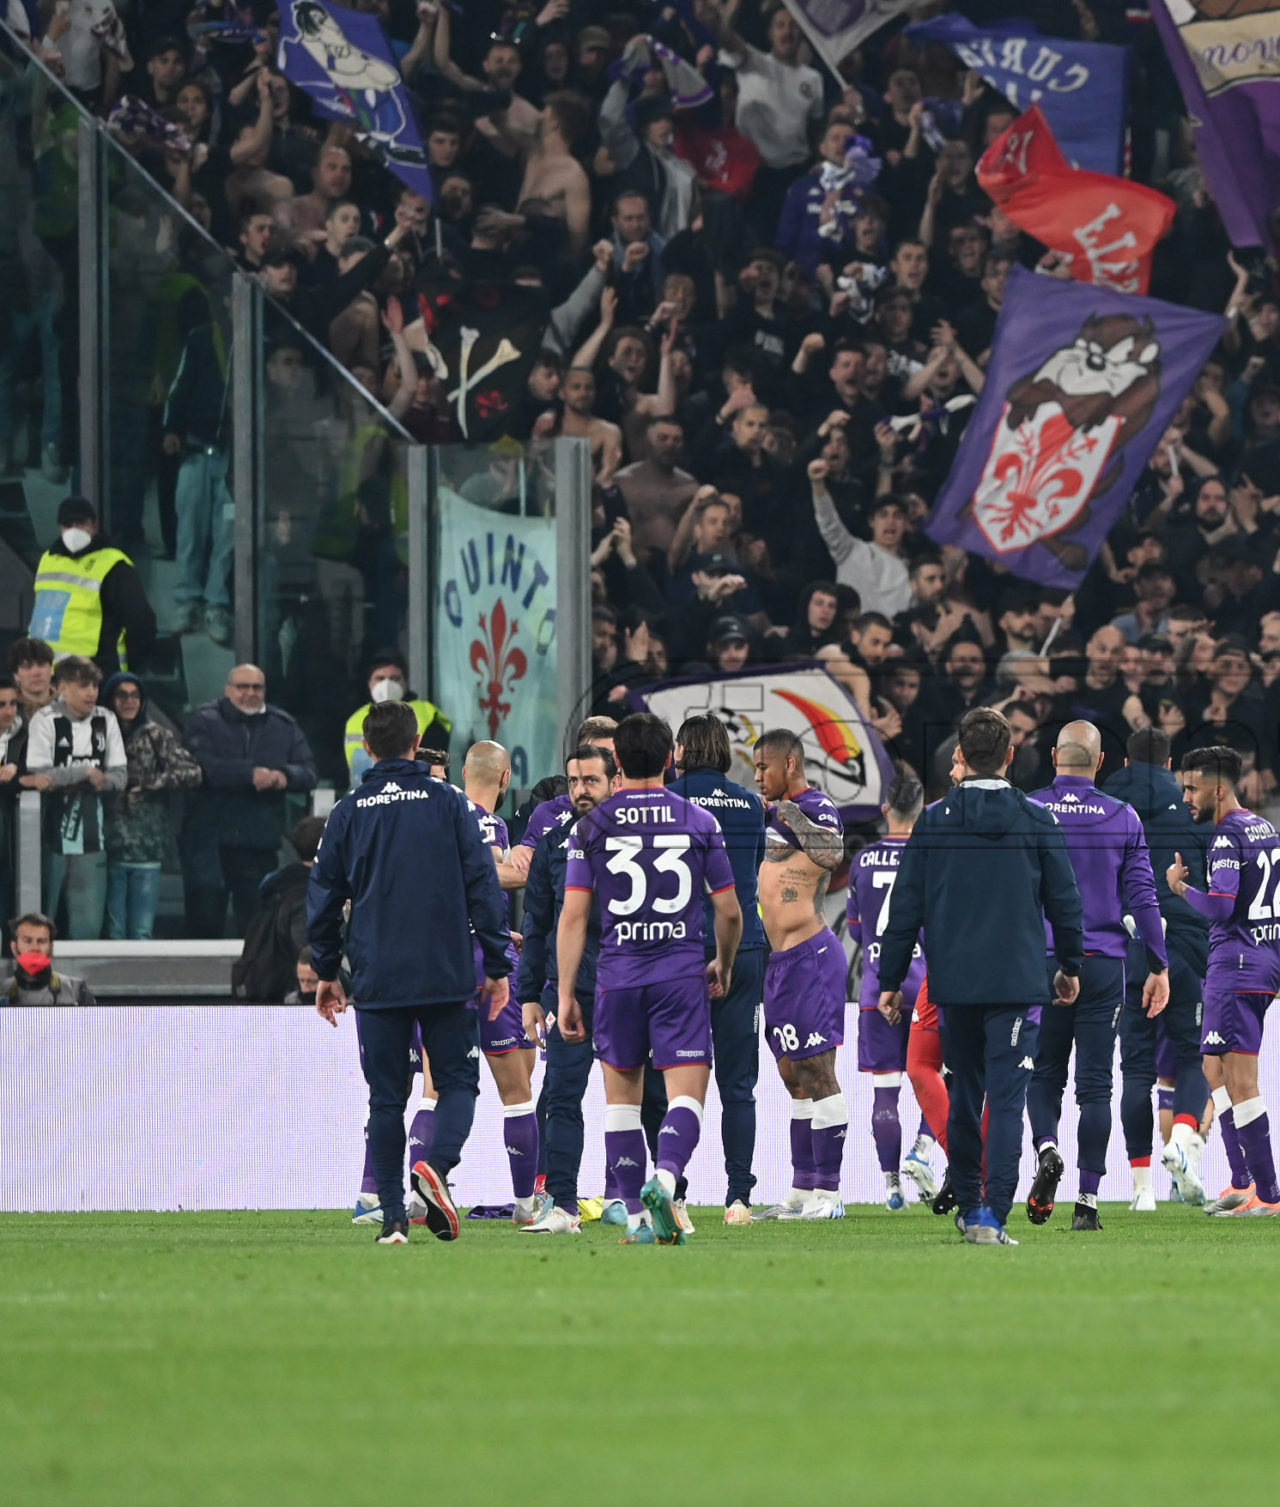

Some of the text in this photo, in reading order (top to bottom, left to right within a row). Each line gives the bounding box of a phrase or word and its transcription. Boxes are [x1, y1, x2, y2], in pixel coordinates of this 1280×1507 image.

[444, 532, 557, 657] QUINTO
[356, 789, 429, 808] FIORENTINA
[689, 796, 751, 809] FIORENTINA
[614, 806, 676, 824] SOTTIL
[1045, 802, 1105, 815] ORENTINA
[860, 850, 900, 867] CALLE
[605, 834, 692, 915] 33
[872, 870, 898, 937] 7
[614, 920, 687, 946] prima
